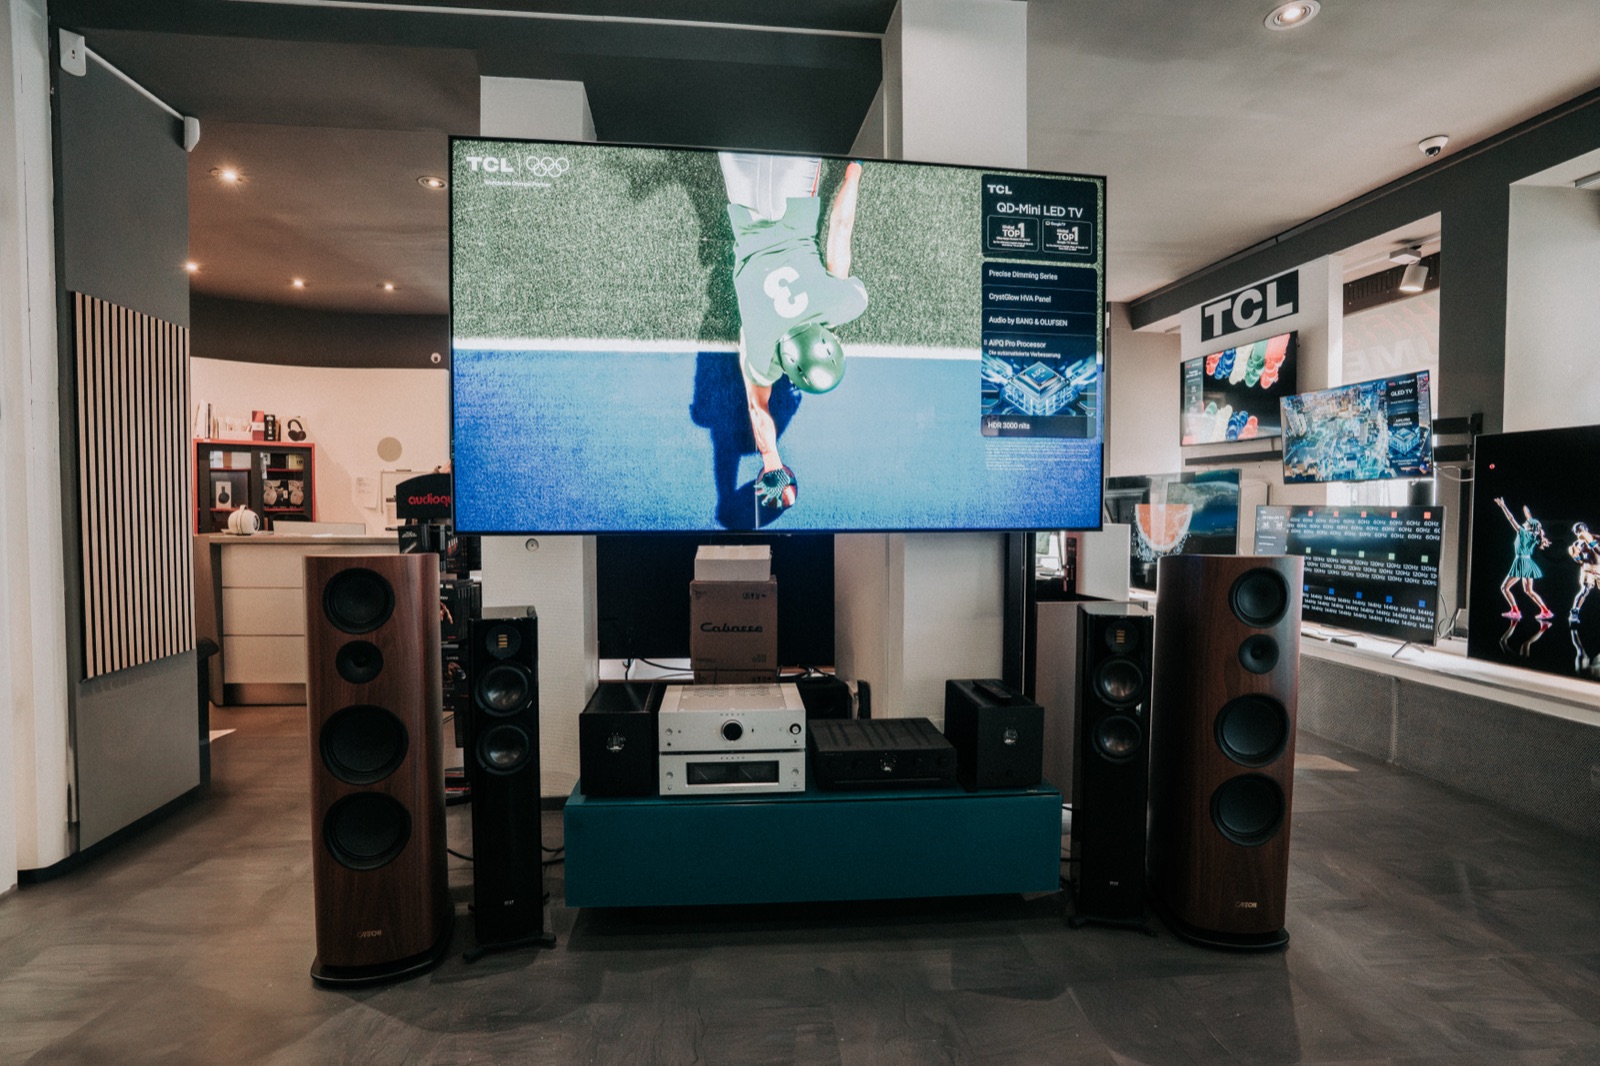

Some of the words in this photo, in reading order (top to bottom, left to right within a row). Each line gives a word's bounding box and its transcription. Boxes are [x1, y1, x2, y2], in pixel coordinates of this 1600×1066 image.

[466, 156, 514, 173] TCL
[987, 184, 1012, 195] TCL
[997, 202, 1041, 215] QD-Mini
[1043, 205, 1065, 217] LED
[1068, 207, 1083, 218] TV
[989, 269, 1011, 278] Precise
[1012, 271, 1039, 281] Dimming
[1039, 272, 1058, 280] Series
[763, 266, 809, 319] 3
[1020, 294, 1034, 302] HVA
[1034, 295, 1051, 303] Panel
[1205, 281, 1293, 337] TCL
[988, 316, 1007, 324] Audio
[1007, 317, 1014, 326] by
[1015, 317, 1033, 325] BANG
[1040, 318, 1068, 327] OLUFSEN
[1016, 340, 1046, 348] Processor
[1018, 422, 1030, 430] nits
[700, 622, 763, 633] Cabasse
